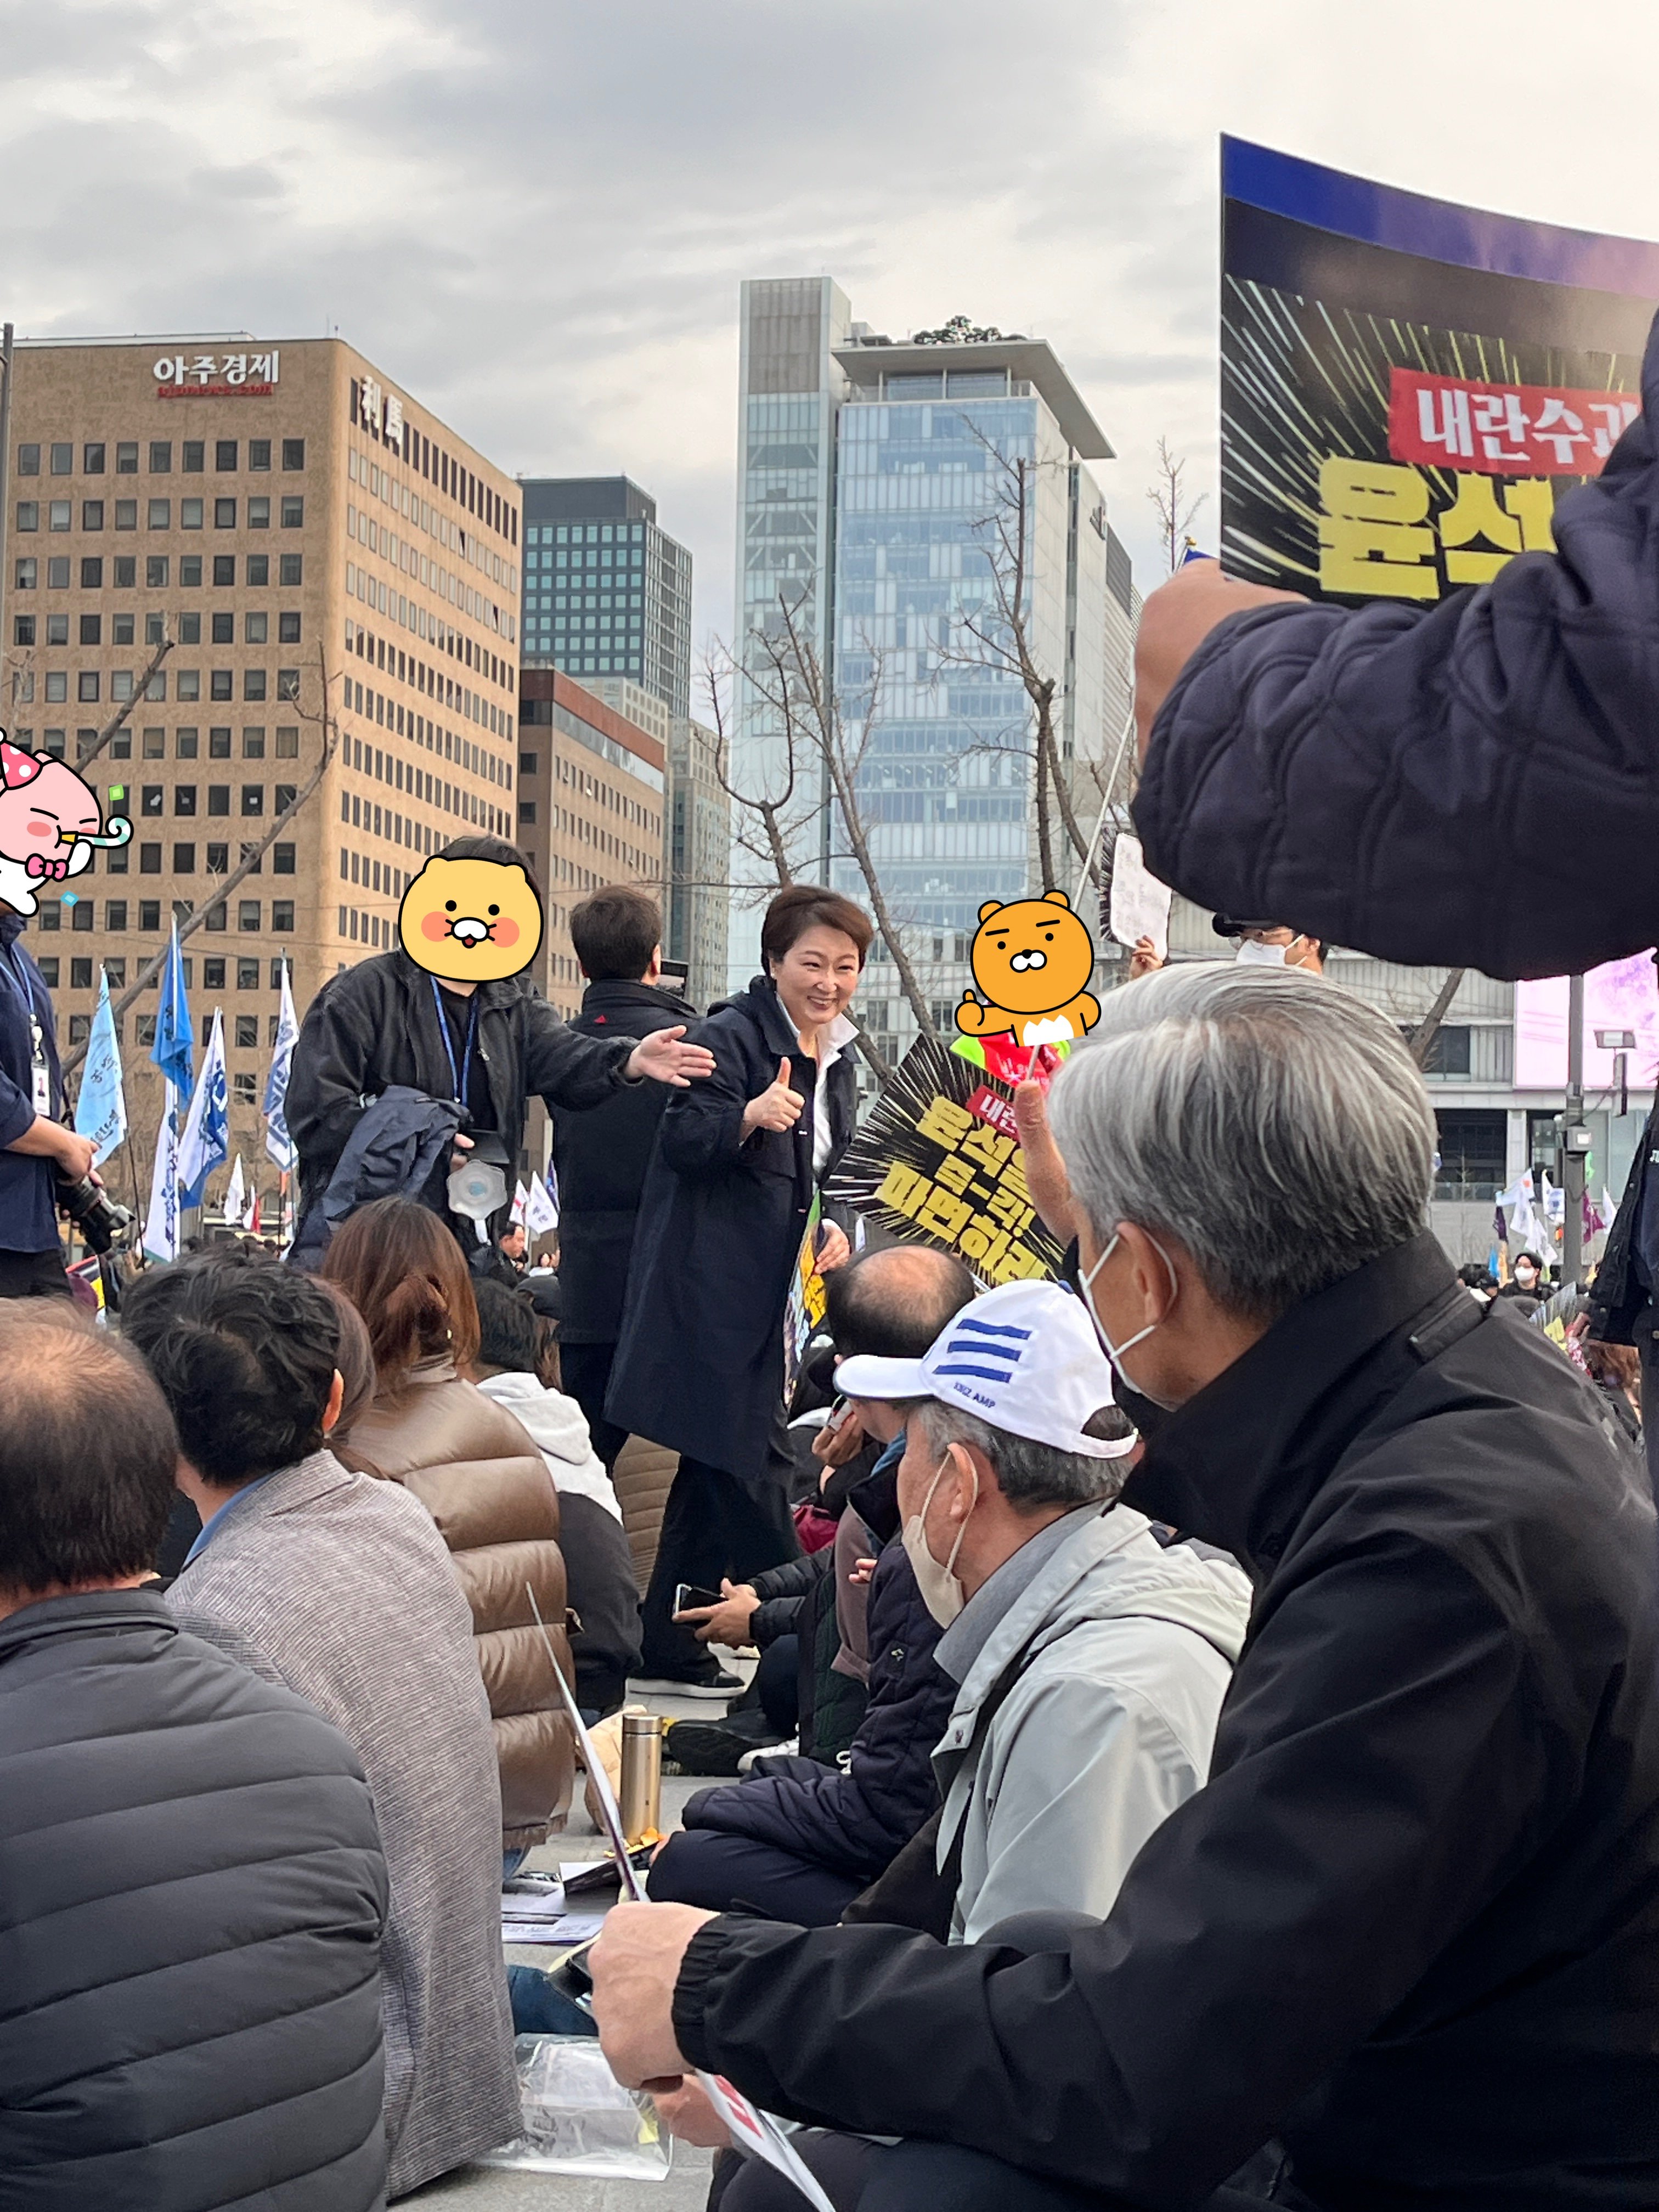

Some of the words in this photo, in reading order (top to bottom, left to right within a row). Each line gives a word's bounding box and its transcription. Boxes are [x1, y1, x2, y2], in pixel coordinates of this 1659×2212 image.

[153, 350, 279, 385] 아주경제
[872, 1160, 1048, 1286] 파면하라
[972, 1392, 996, 1408] AMP
